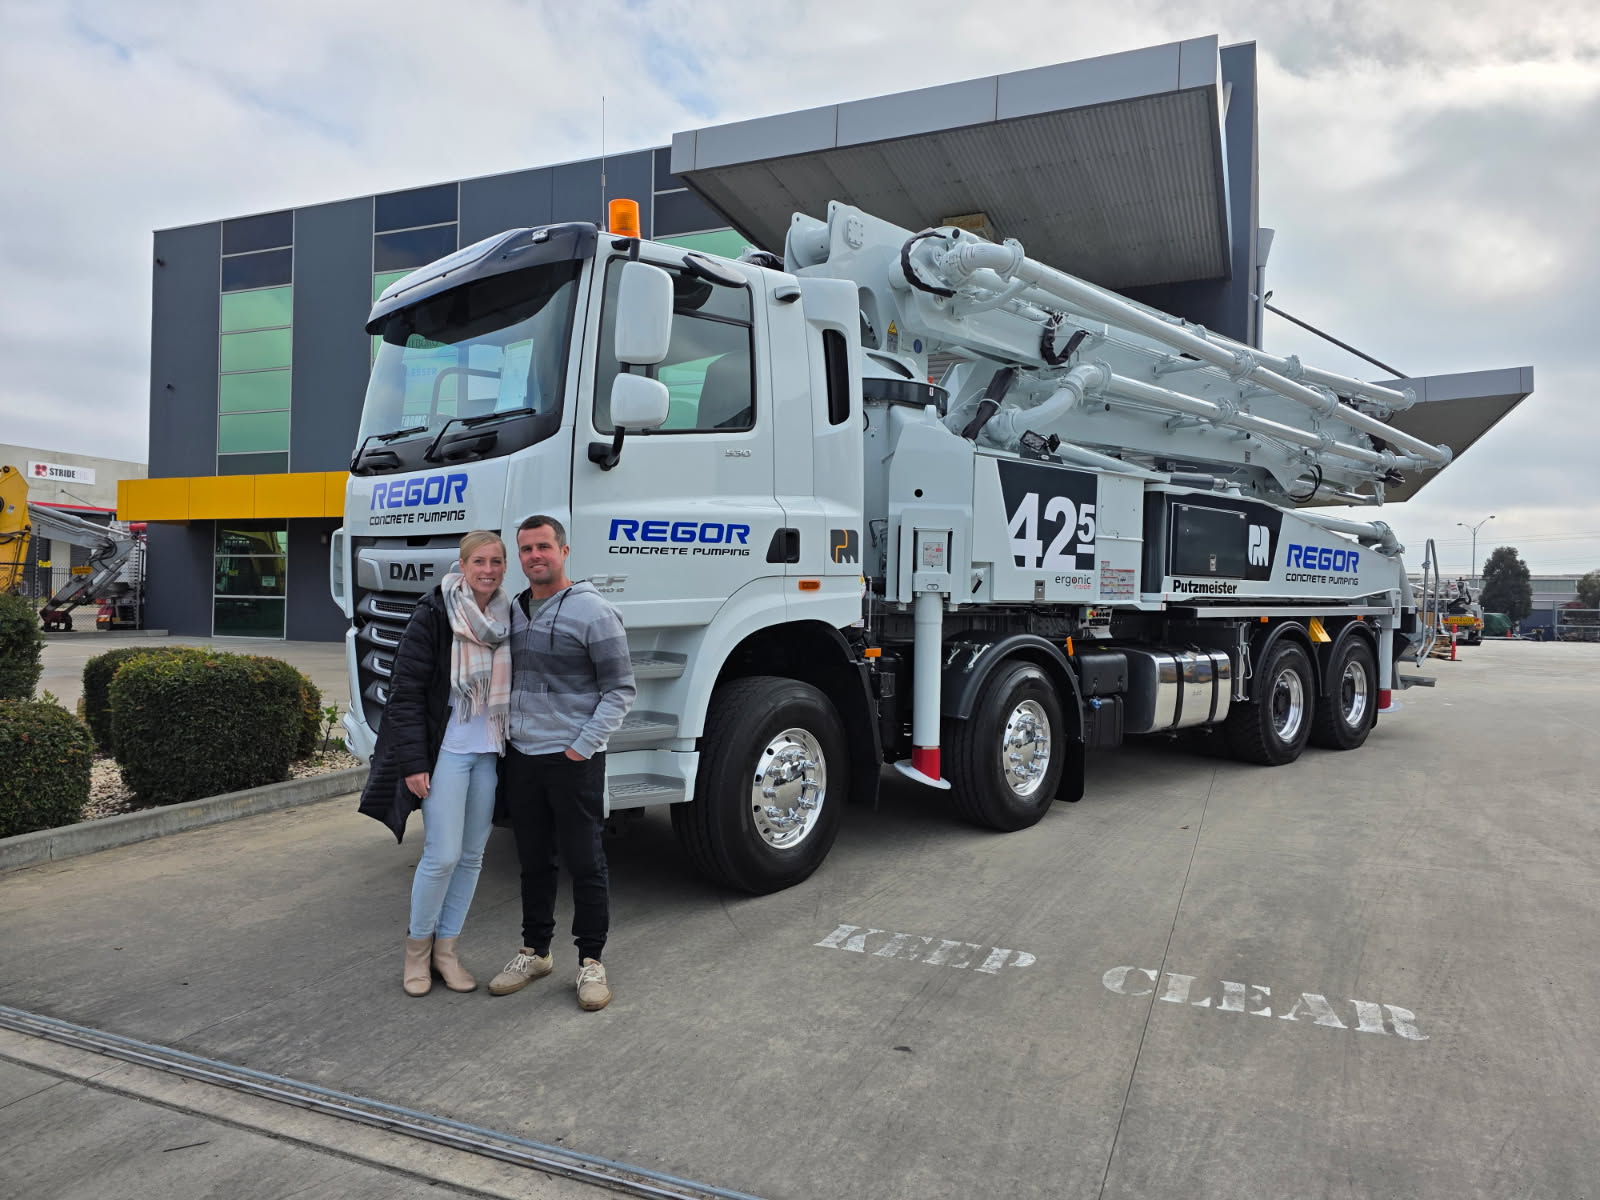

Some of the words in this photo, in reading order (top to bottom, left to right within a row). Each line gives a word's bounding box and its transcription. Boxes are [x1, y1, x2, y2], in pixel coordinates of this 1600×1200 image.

[725, 449, 752, 458] 530
[49, 467, 76, 478] STRIDE
[370, 473, 469, 511] REGOR
[369, 513, 415, 526] CONCRETE
[417, 509, 466, 523] PUMPING
[608, 518, 750, 545] REGOR
[608, 545, 689, 556] CONCRETE
[692, 547, 750, 557] PUMPING
[1286, 543, 1360, 574] REGOR
[389, 562, 434, 582] DAF
[1055, 574, 1092, 587] ergonic
[1285, 573, 1327, 584] CONCRETE
[1328, 576, 1359, 586] PUMPING
[1173, 579, 1238, 594] Putzmeister
[813, 923, 1037, 975] KEEP
[1101, 966, 1430, 1041] CLEAR
